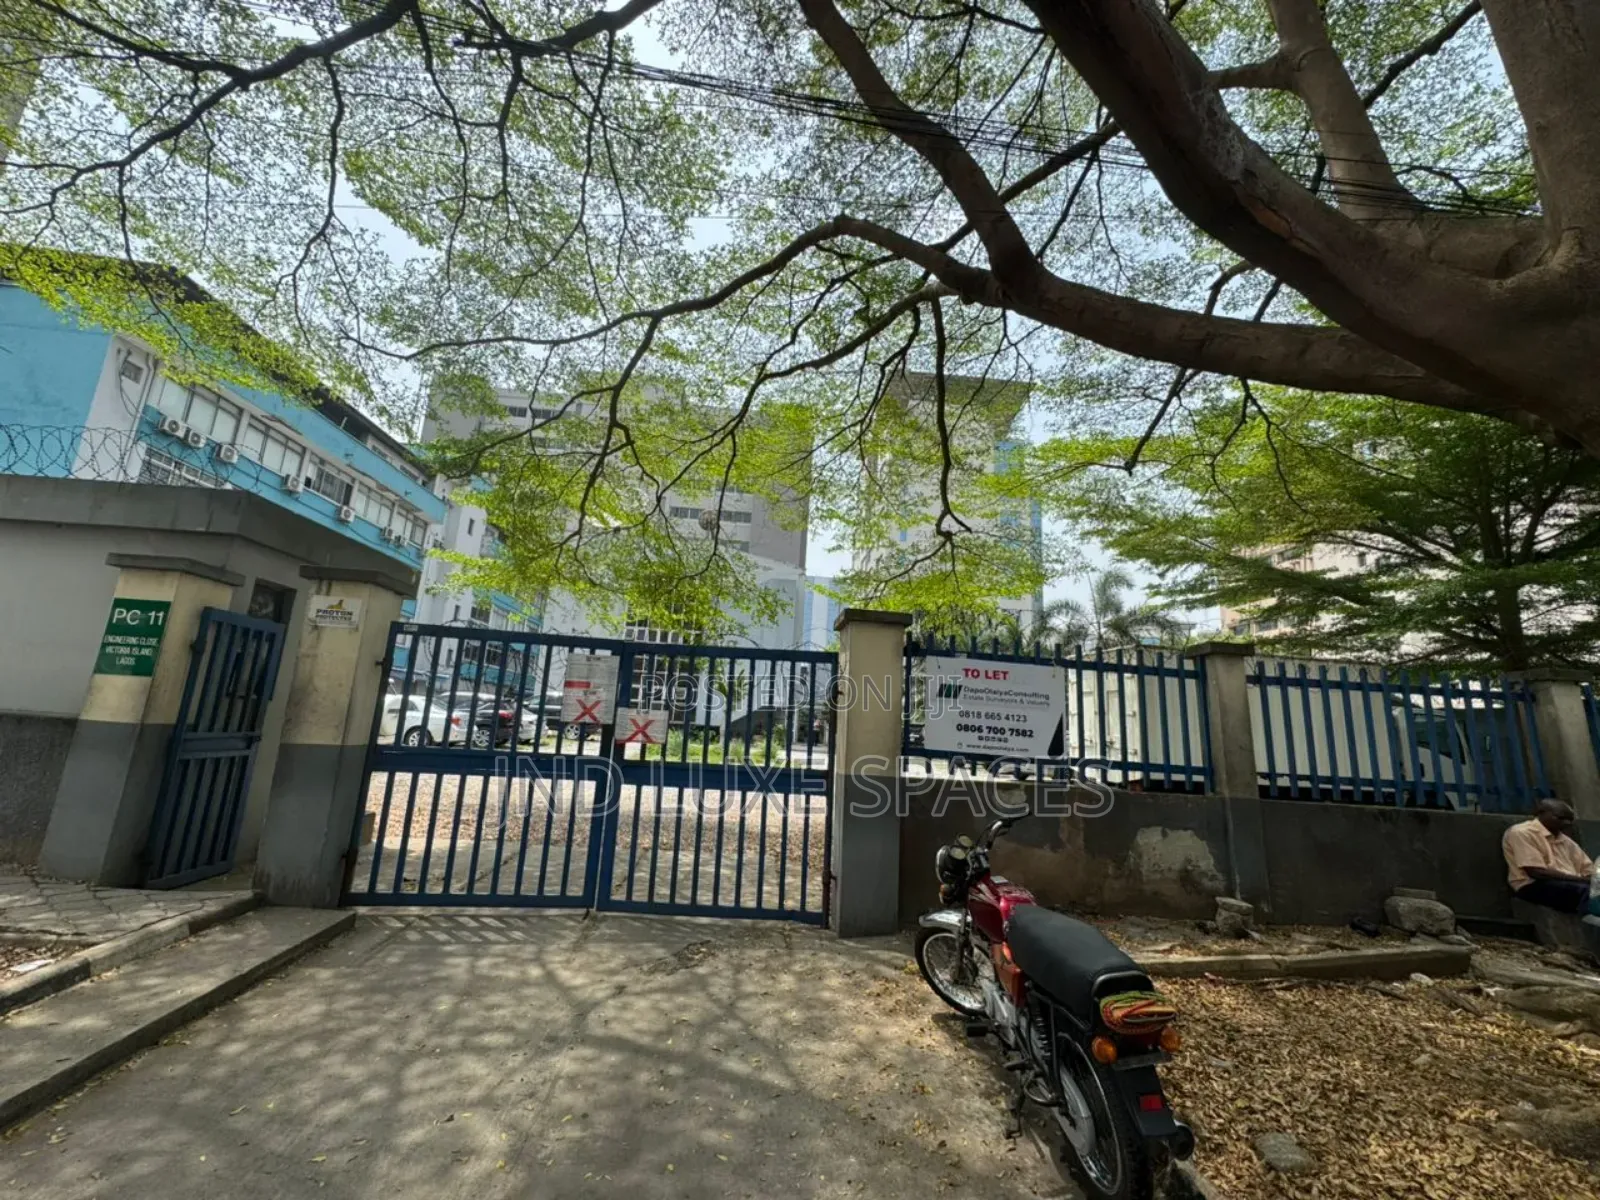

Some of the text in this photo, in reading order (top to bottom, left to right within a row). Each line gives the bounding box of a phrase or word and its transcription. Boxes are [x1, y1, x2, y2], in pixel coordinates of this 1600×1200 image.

[112, 608, 165, 625] PC 11
[962, 668, 1010, 681] TO LET
[958, 710, 1028, 723] 0818 665 4123
[956, 723, 1035, 738] 0806 700 7582
